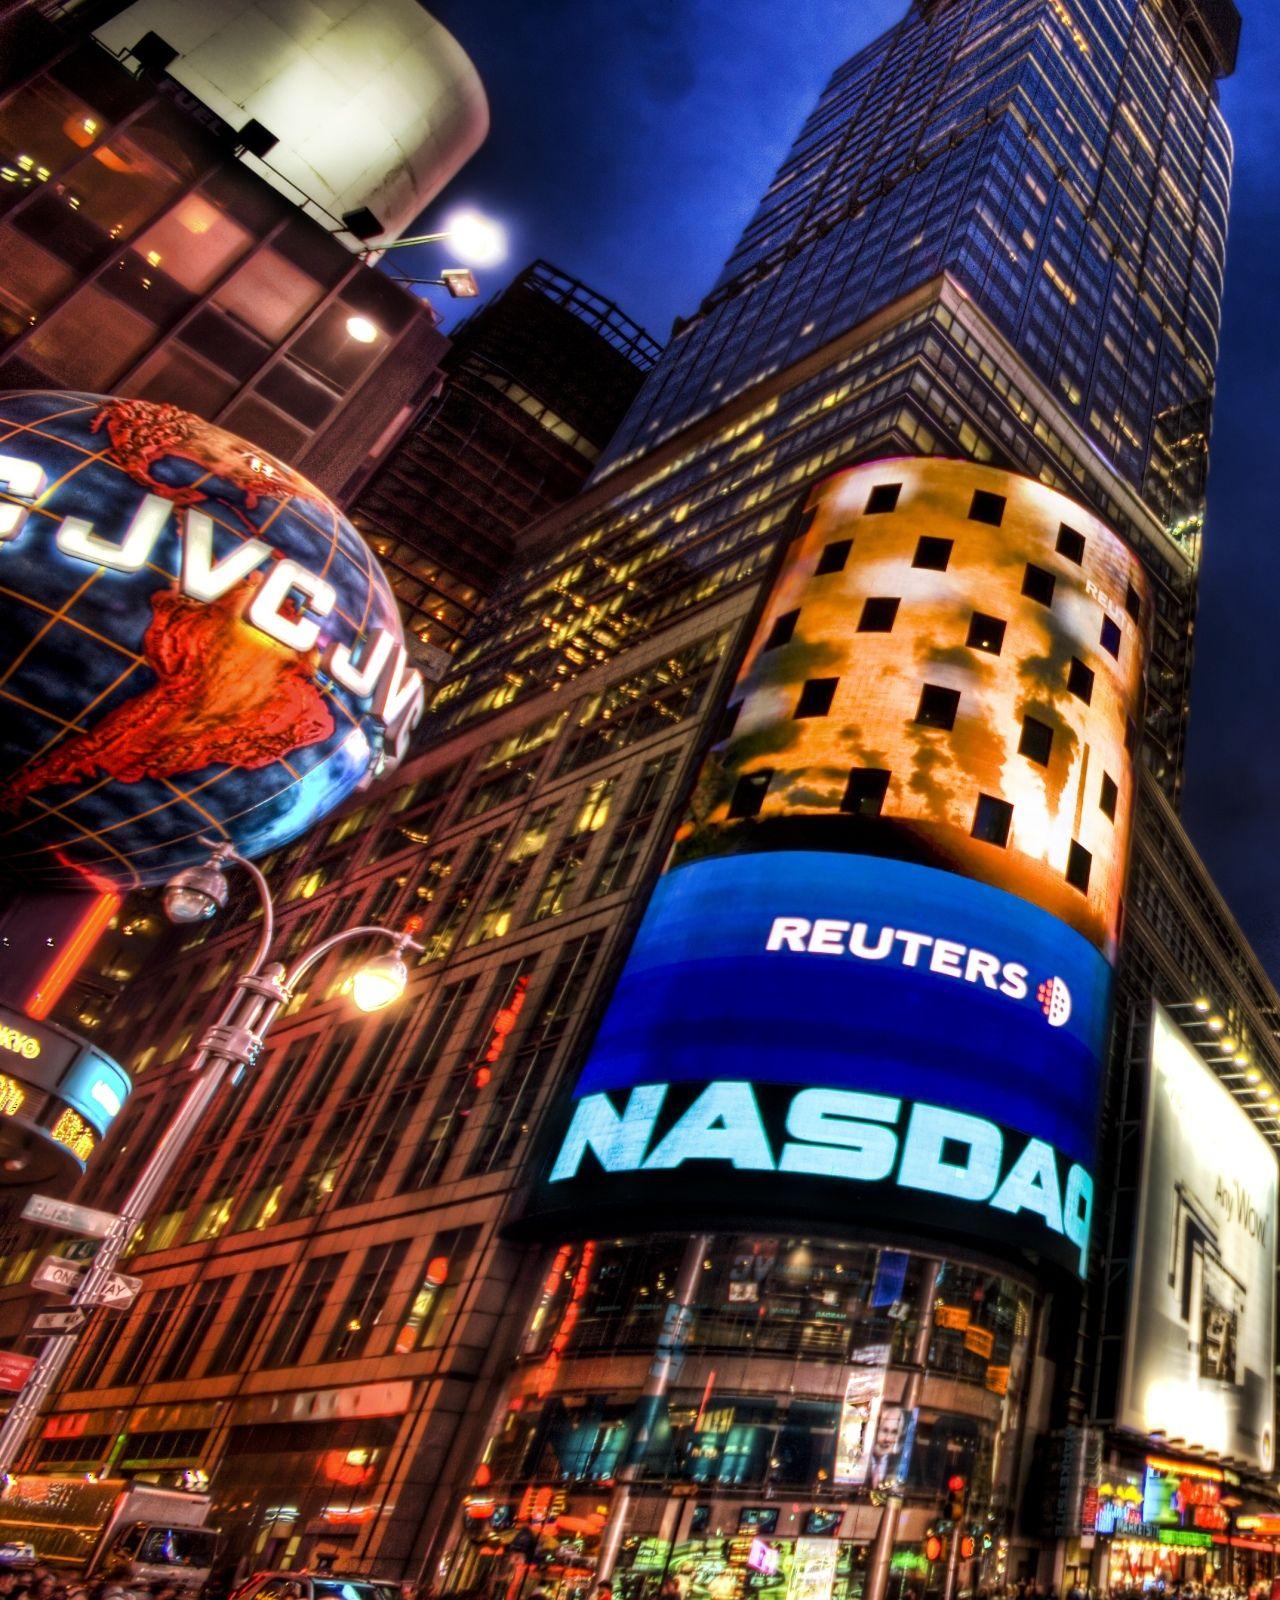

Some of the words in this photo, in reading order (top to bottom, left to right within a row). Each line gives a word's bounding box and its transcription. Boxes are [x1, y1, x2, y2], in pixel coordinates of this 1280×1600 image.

[157, 78, 223, 137] FUEL
[56, 494, 336, 652] JVC
[766, 917, 1028, 999] REUTERS
[549, 1081, 1095, 1281] NASDAQ
[53, 1269, 79, 1284] ONE
